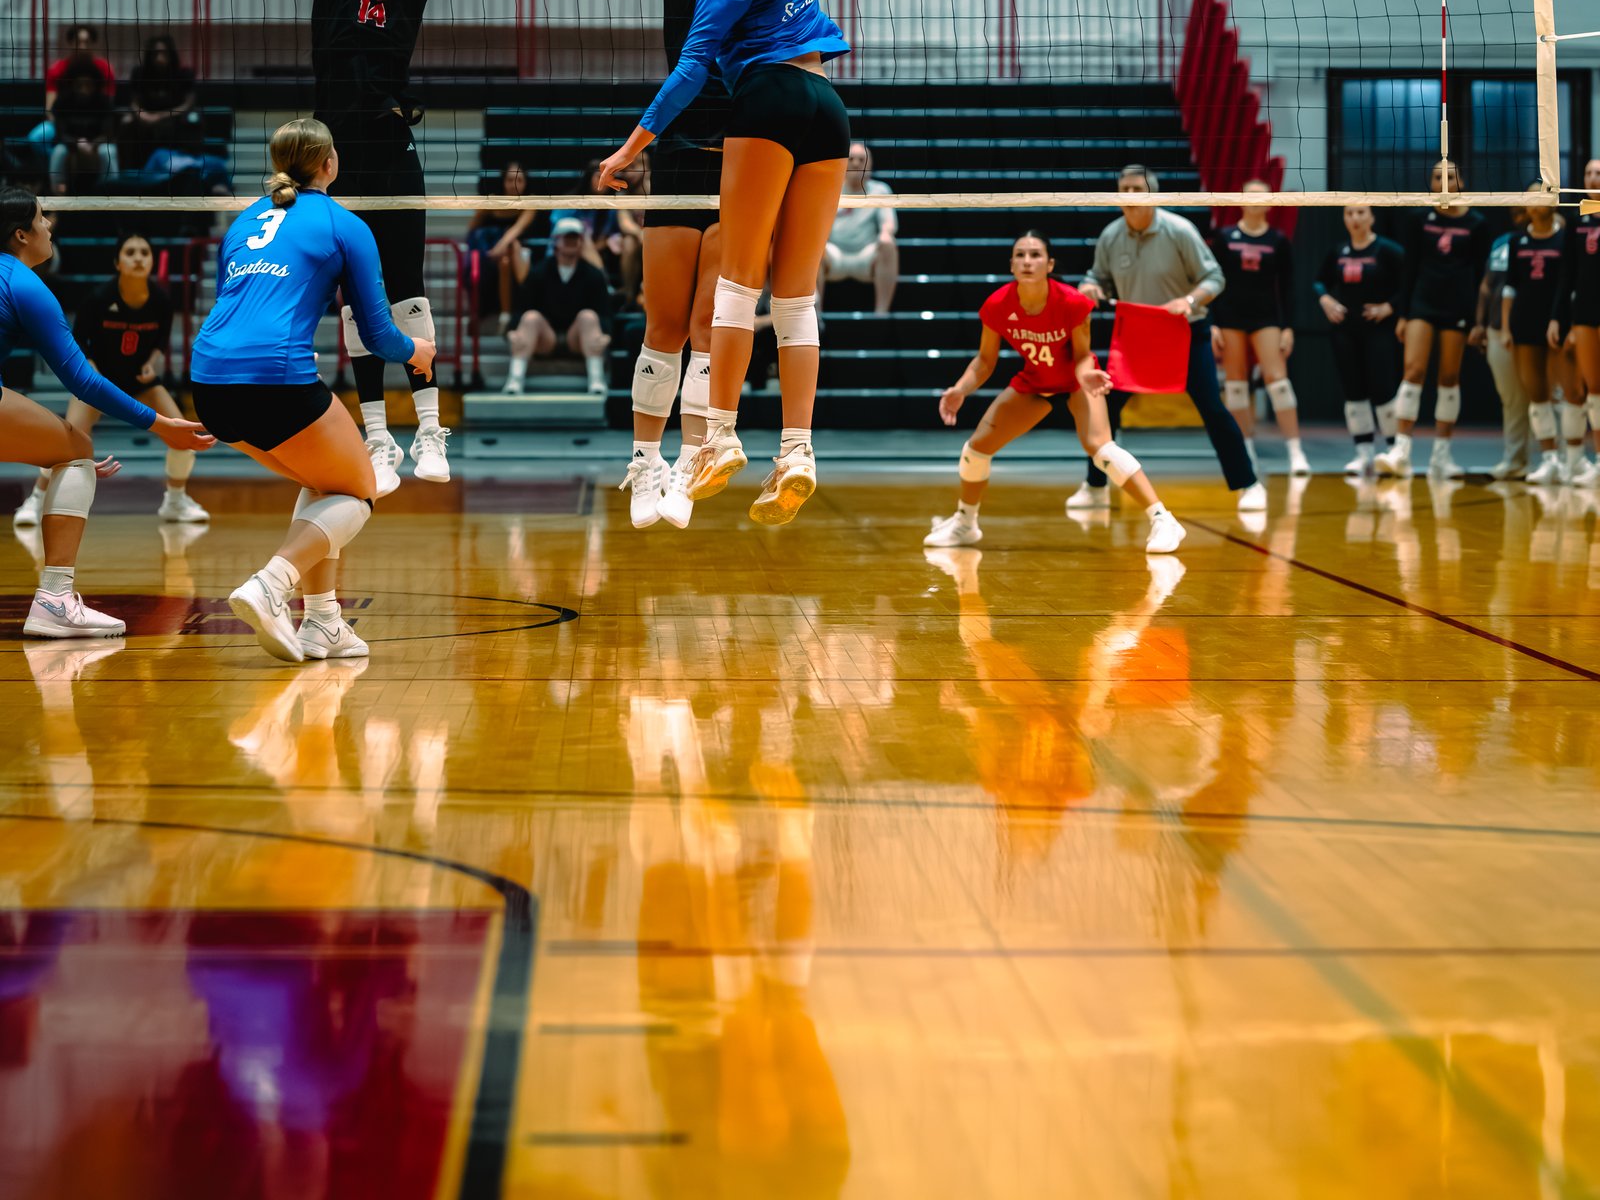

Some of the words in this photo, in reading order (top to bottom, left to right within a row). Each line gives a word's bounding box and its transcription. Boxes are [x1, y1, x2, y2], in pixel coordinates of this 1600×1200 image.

[246, 208, 287, 250] 3
[225, 258, 290, 284] Spartans
[1021, 342, 1054, 367] 24
